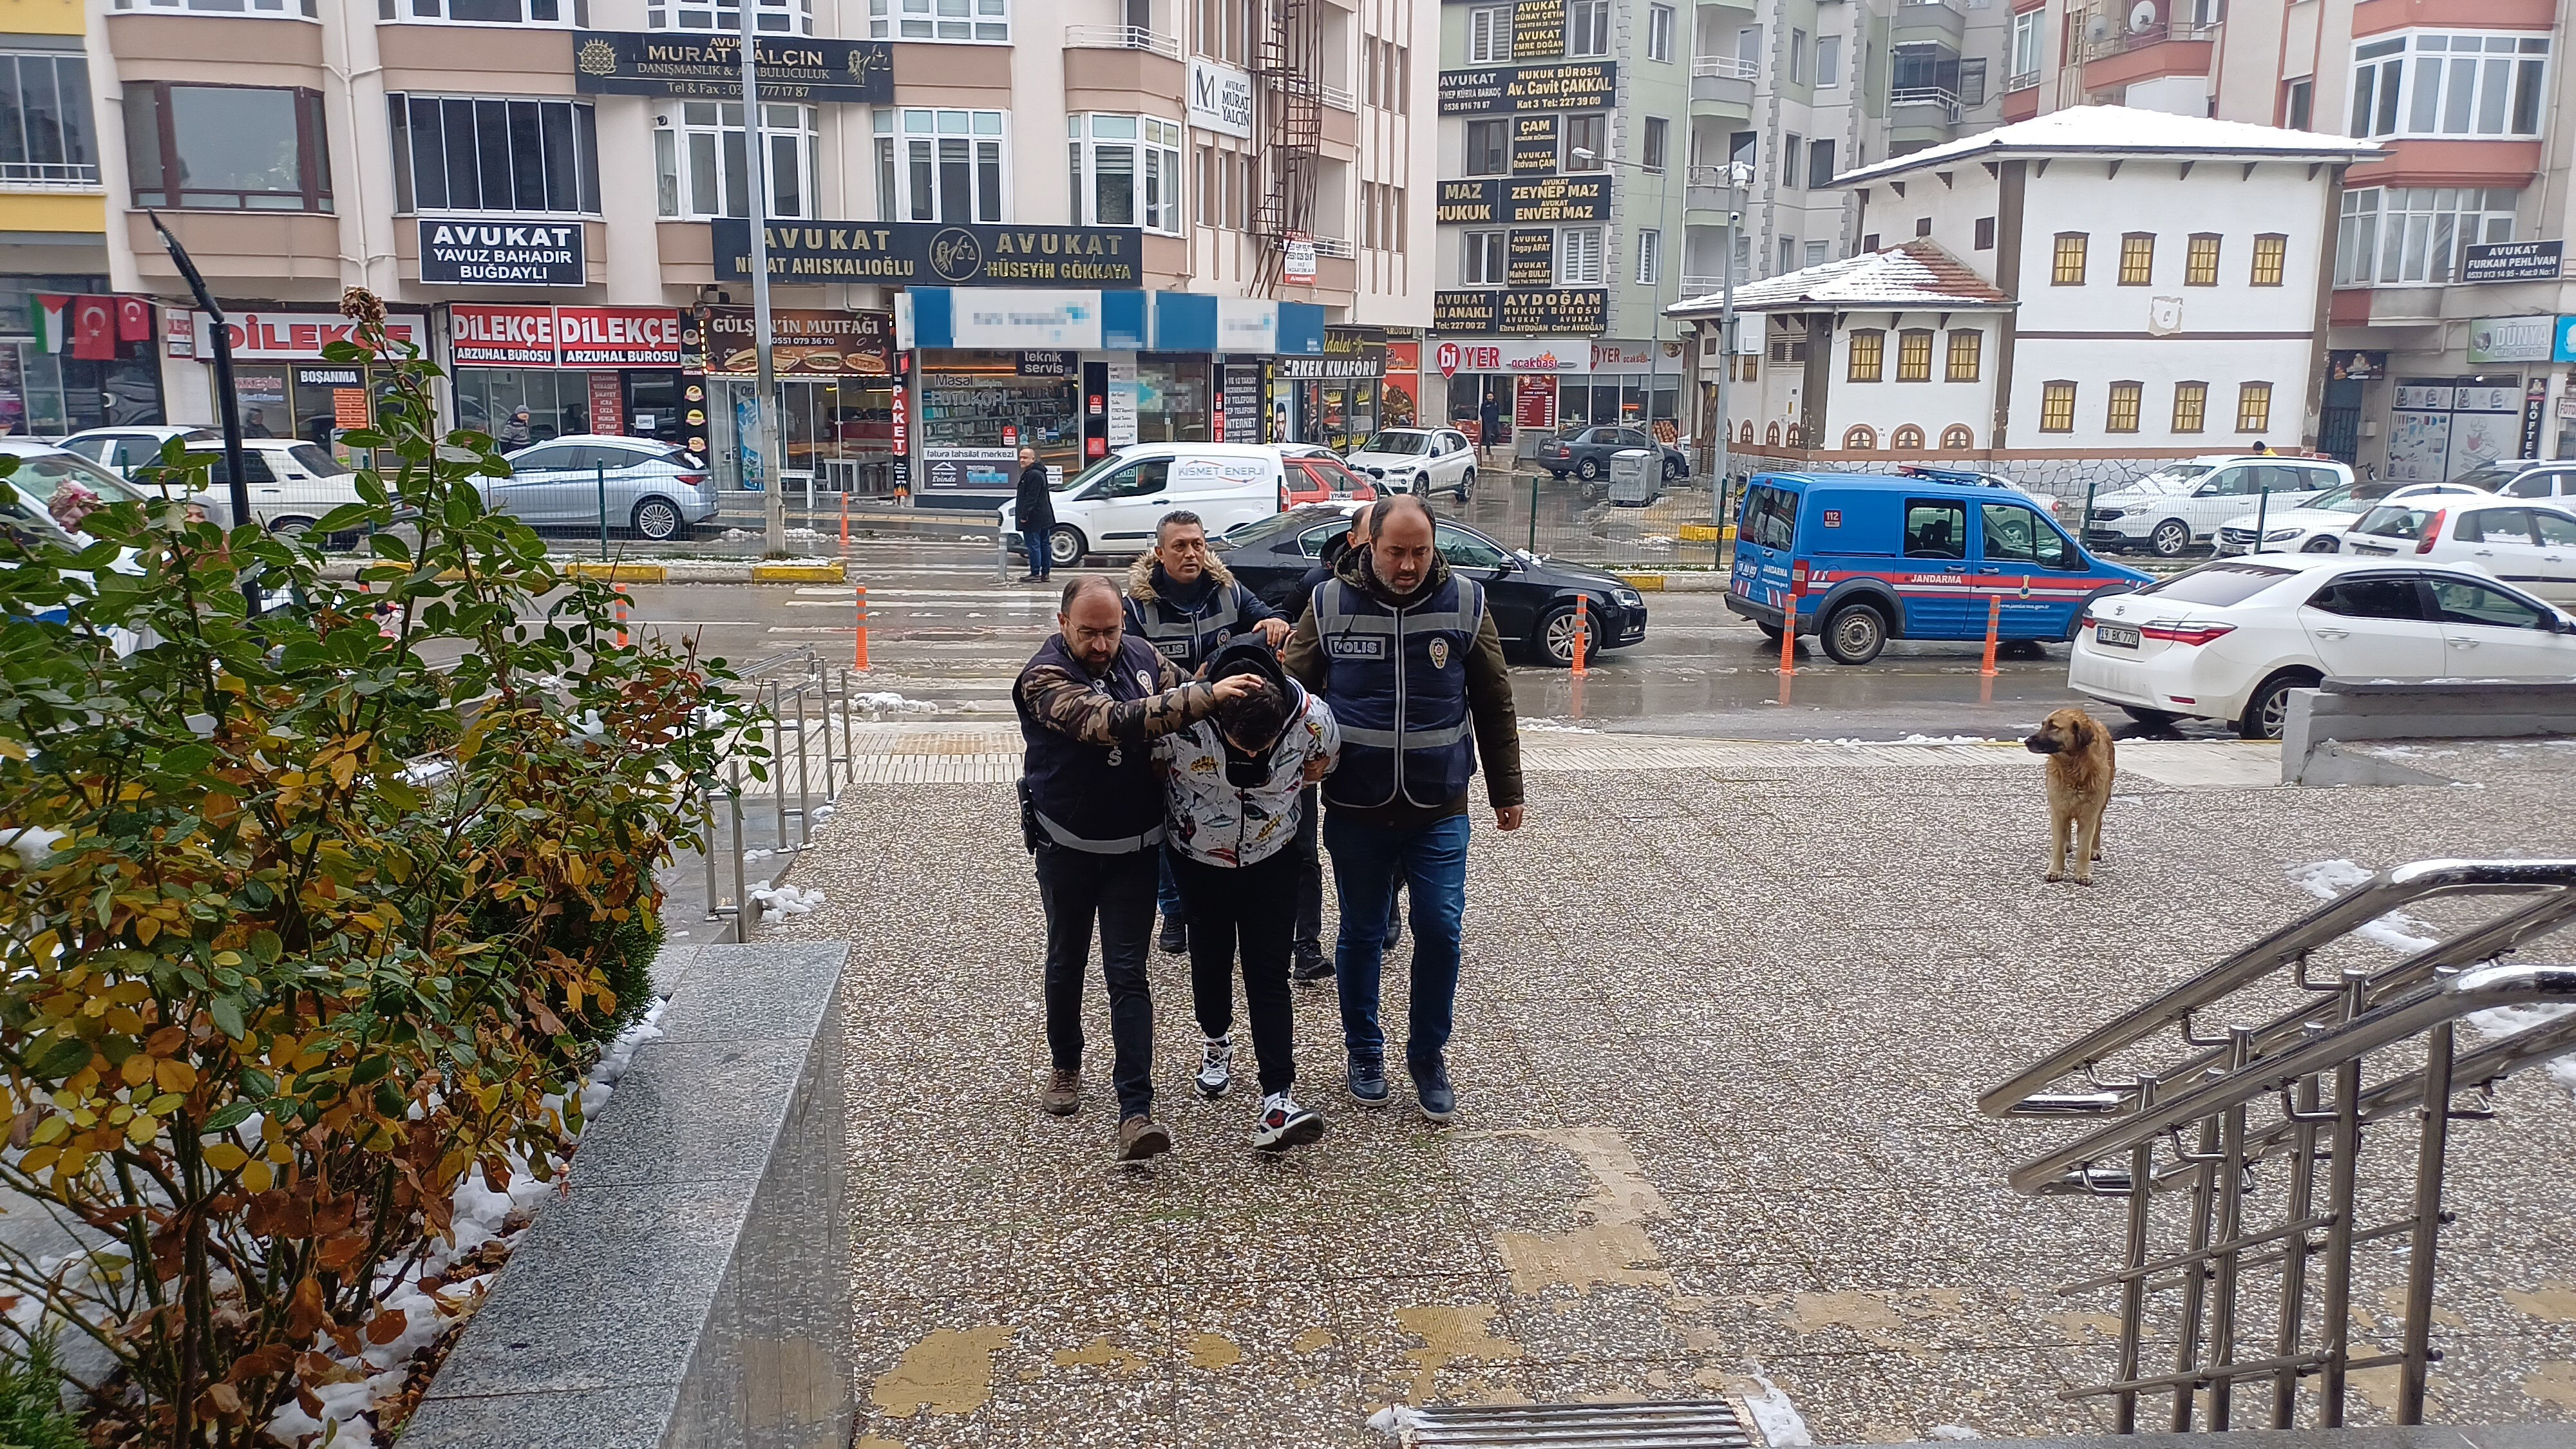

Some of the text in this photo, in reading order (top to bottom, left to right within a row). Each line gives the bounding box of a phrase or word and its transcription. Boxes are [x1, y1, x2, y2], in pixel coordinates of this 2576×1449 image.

[1518, 0, 1562, 12] AVUKAT
[1542, 10, 1564, 20] ÇETİN
[710, 37, 762, 48] AVUKT
[1517, 30, 1561, 41] AVUKAT
[1537, 40, 1563, 48] DOĞAN
[649, 45, 730, 62] MURAT
[638, 63, 829, 79] DANIŞMANLIK & ABULUCULUK
[1517, 66, 1601, 80] HUKUK BÜROSU
[1225, 80, 1245, 93] AVUKAT
[1440, 73, 1496, 87] AVUKAT
[1507, 77, 1613, 97] Av. Cavit ÇAKKAL
[667, 82, 809, 97] Tel & Fax 777 17 87
[1222, 90, 1250, 110] MURAT
[1444, 102, 1459, 111] 0536
[1517, 100, 1532, 109] Kat
[1533, 99, 1539, 108] 3
[1559, 97, 1575, 107] 227
[1577, 97, 1587, 106] 39
[1222, 105, 1249, 128] YALÇIN
[1521, 120, 1549, 135] ÇAM
[1539, 158, 1556, 169] ÇAM
[1444, 184, 1482, 200] MAZ
[1511, 184, 1598, 200] ZEYNEP MAZ
[1515, 205, 1593, 220] ENVER MAZ
[433, 225, 571, 247] AVUKAT
[764, 227, 890, 251] AVUKAT
[996, 232, 1122, 255] AVUKAT
[1533, 243, 1551, 252] AFAT
[2488, 245, 2539, 256] AVUKAT
[433, 249, 573, 263] YAVUZ BAHADIR
[2468, 255, 2557, 269] FURKAN PEHLİVAN
[460, 263, 547, 279] BUĞDAYLI
[735, 252, 914, 276] NİAT AHISKALIOĞLU
[987, 258, 1132, 279] HÜSEYİN GÖKKAYA
[1509, 270, 1528, 278] Mahir
[1436, 294, 1486, 305] AVUKAT
[1504, 290, 1601, 305] AYDOĞAN
[1448, 307, 1493, 317] ANAKLI
[1551, 305, 1600, 314] BÜROSU
[453, 314, 552, 347] DİLEKÇE
[561, 316, 678, 348] DİLEKÇE
[712, 315, 879, 336] GÜLŞN'İN MUTFAĞI
[2496, 321, 2548, 346] DÜNYA
[1324, 332, 1352, 353] dalet
[457, 347, 551, 362] ARZUHAL BÜROSU
[566, 350, 677, 363] ARZUHAL BÜROSU
[1025, 351, 1062, 362] teknik
[1440, 345, 1558, 370] bi YER ocakbaşı
[1602, 346, 1620, 363] YER
[1025, 363, 1063, 374] servis
[1284, 356, 1378, 377] ERKEK KUAFÖRÜ
[300, 370, 357, 384] BOŞANMA
[936, 374, 973, 386] Masal
[1232, 395, 1256, 404] TELEFONU
[893, 385, 905, 450] PAKET
[1226, 417, 1256, 428] NTERNET
[1178, 465, 1265, 477] KISMET ENERJİ
[1826, 512, 1839, 520] 112
[1763, 564, 1788, 578] JANDARMA
[1911, 574, 1962, 584] JANDARMA
[2100, 629, 2137, 643] 19 BK 770
